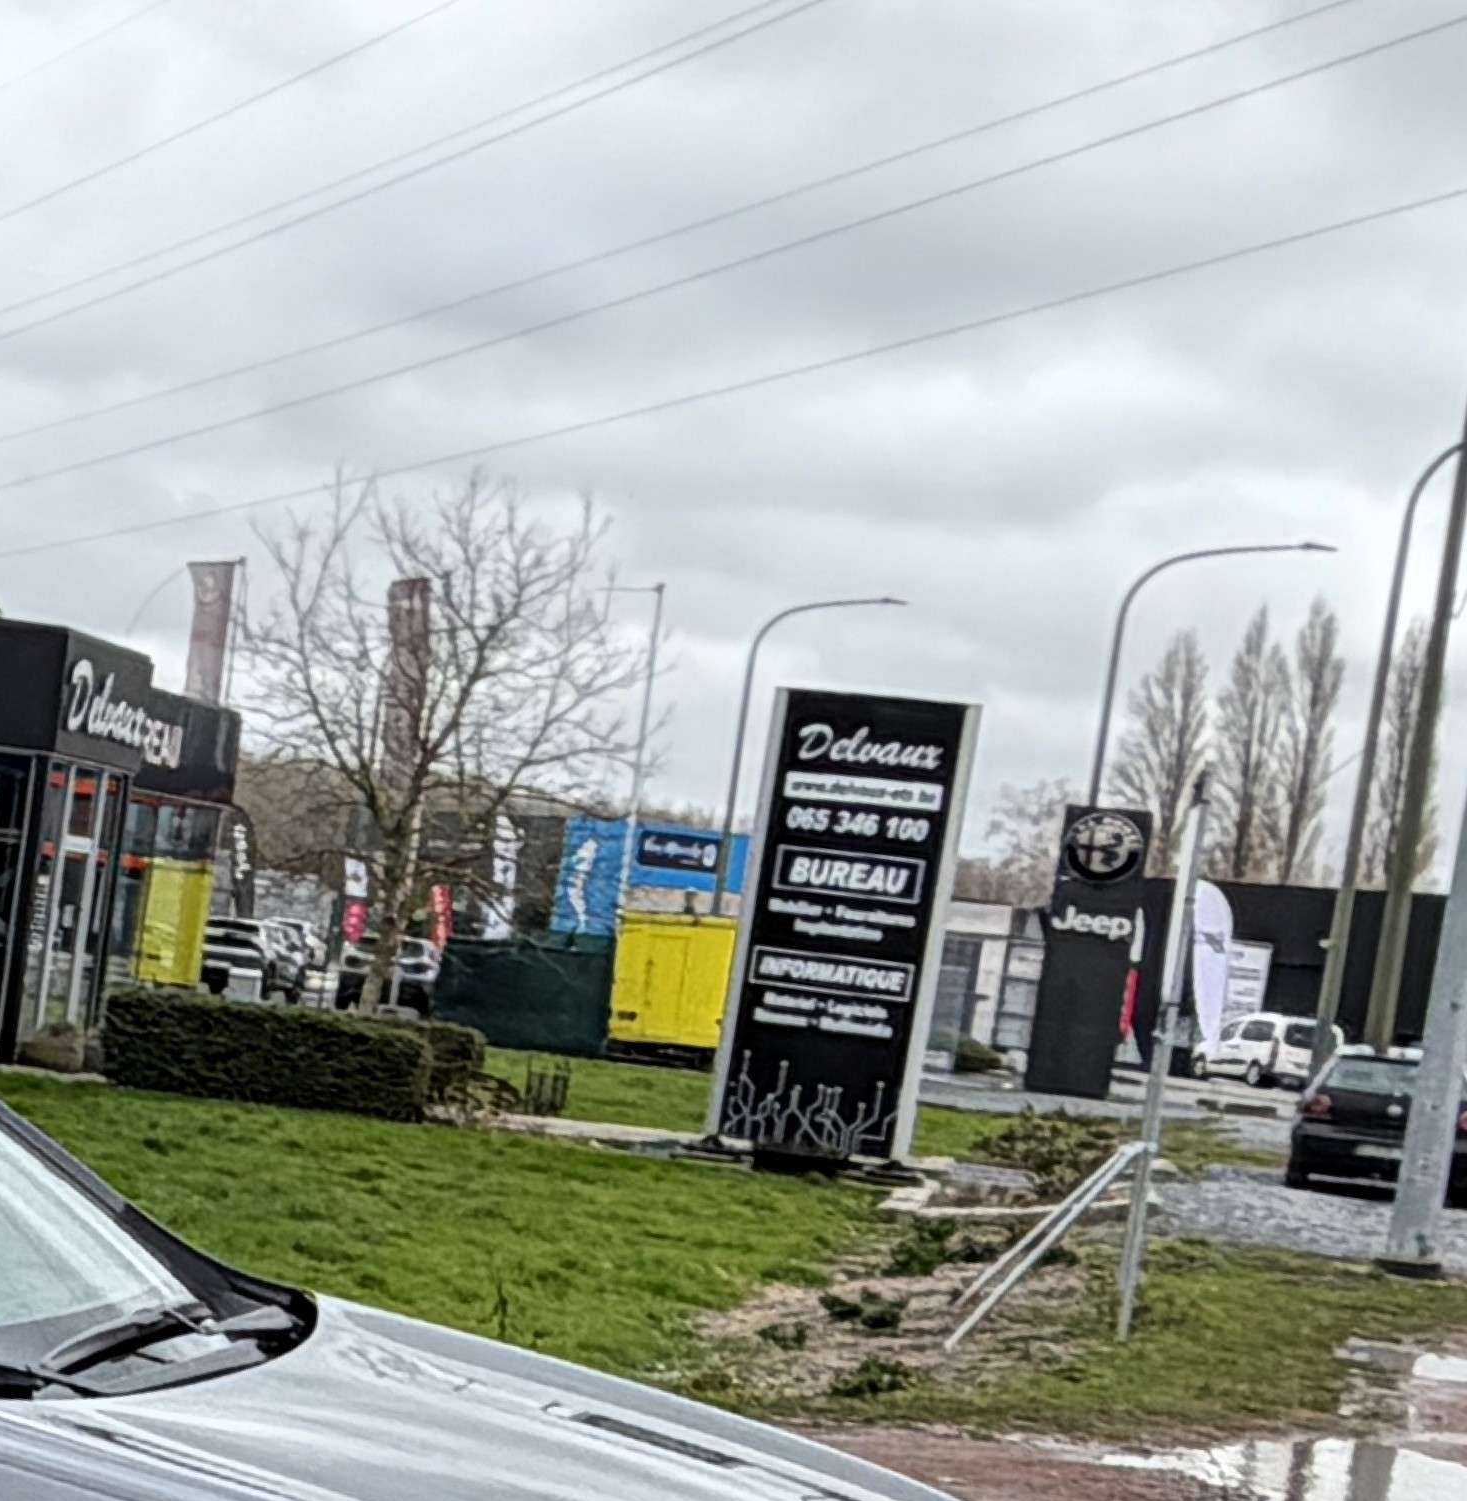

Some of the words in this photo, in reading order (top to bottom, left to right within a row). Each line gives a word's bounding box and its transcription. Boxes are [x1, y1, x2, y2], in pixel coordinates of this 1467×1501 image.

[798, 723, 944, 770] Delvaux
[786, 805, 832, 832] 065
[832, 809, 881, 838] 346
[885, 815, 931, 843] 100
[788, 855, 910, 895] BUREAU
[1050, 903, 1132, 941] Jeep
[758, 955, 906, 992] INFORMATIQUE
